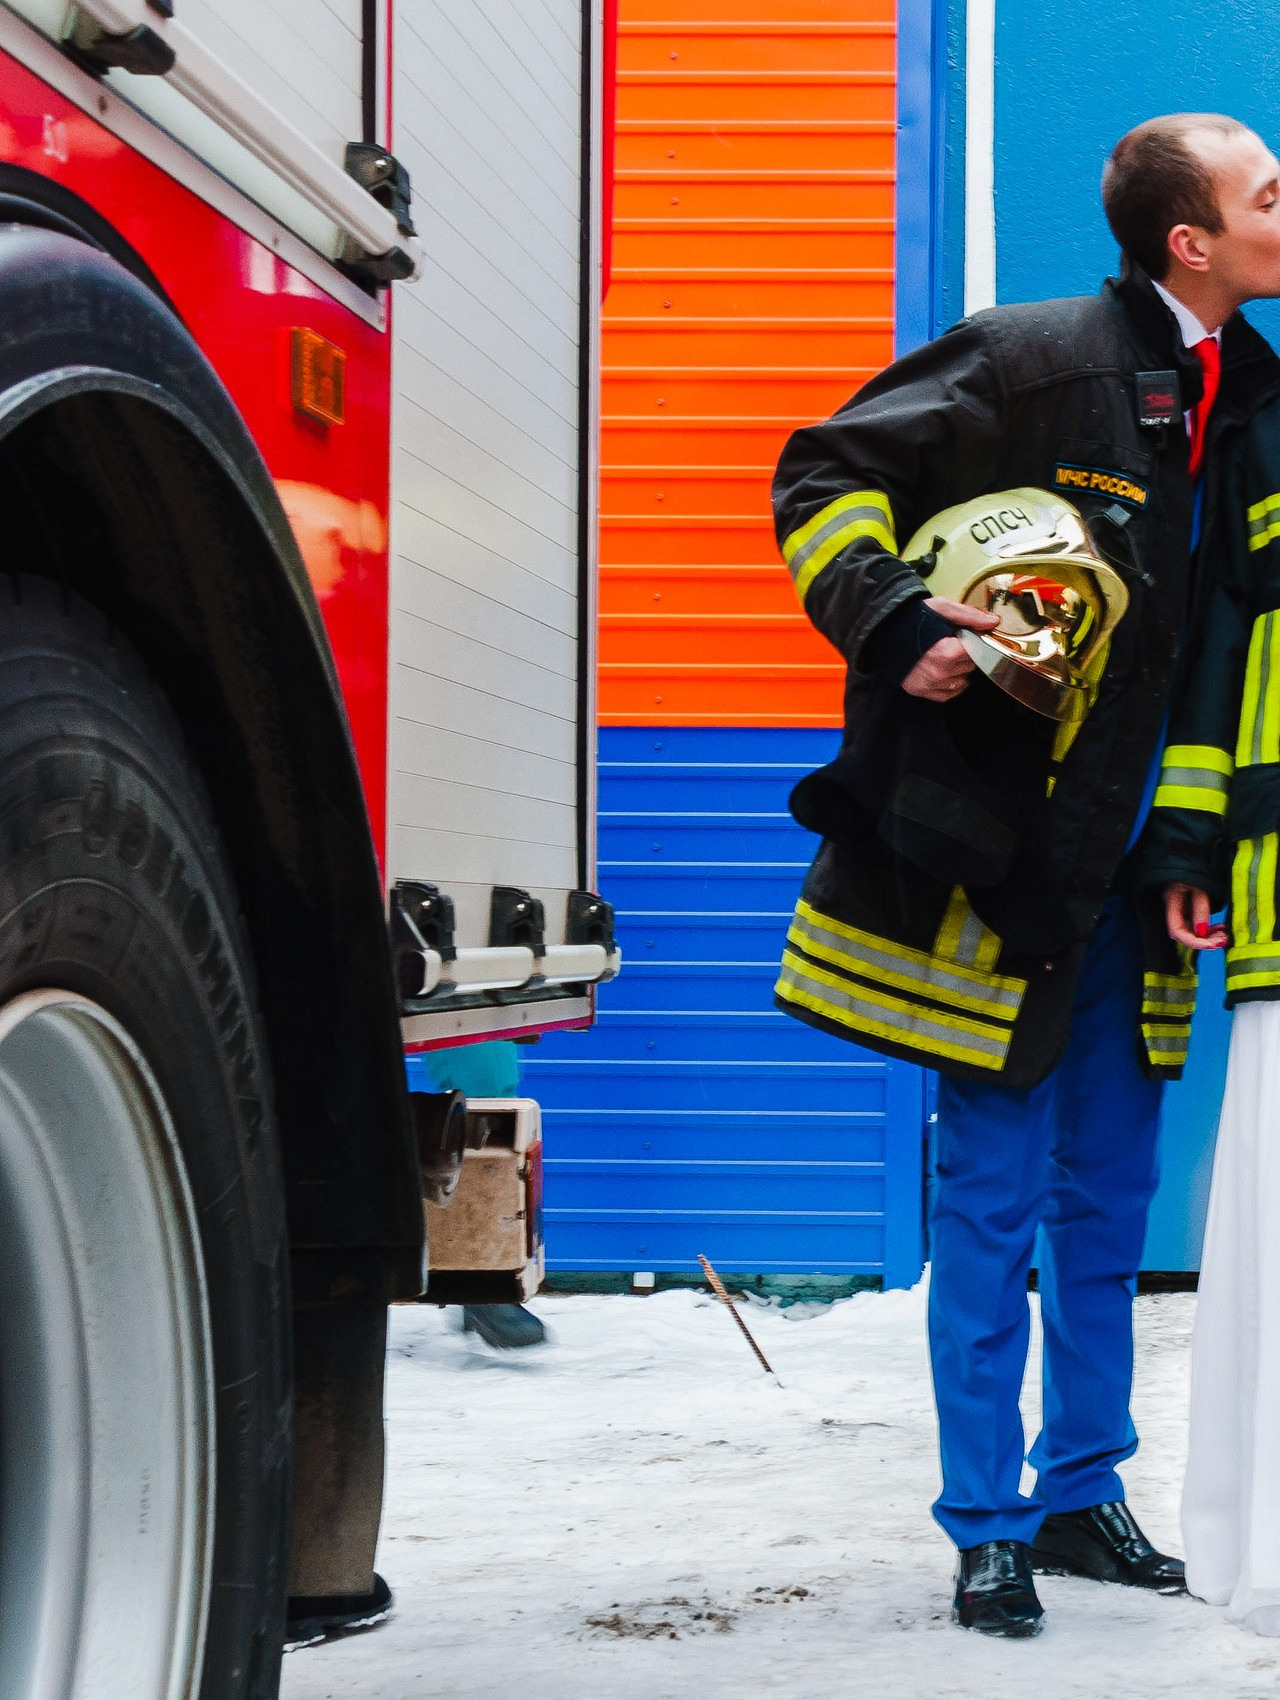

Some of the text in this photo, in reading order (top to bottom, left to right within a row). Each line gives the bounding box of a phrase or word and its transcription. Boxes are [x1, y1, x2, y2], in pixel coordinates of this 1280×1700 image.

[1056, 468, 1146, 504] МЧС РОССИИ
[969, 507, 1033, 544] СПСЧ
